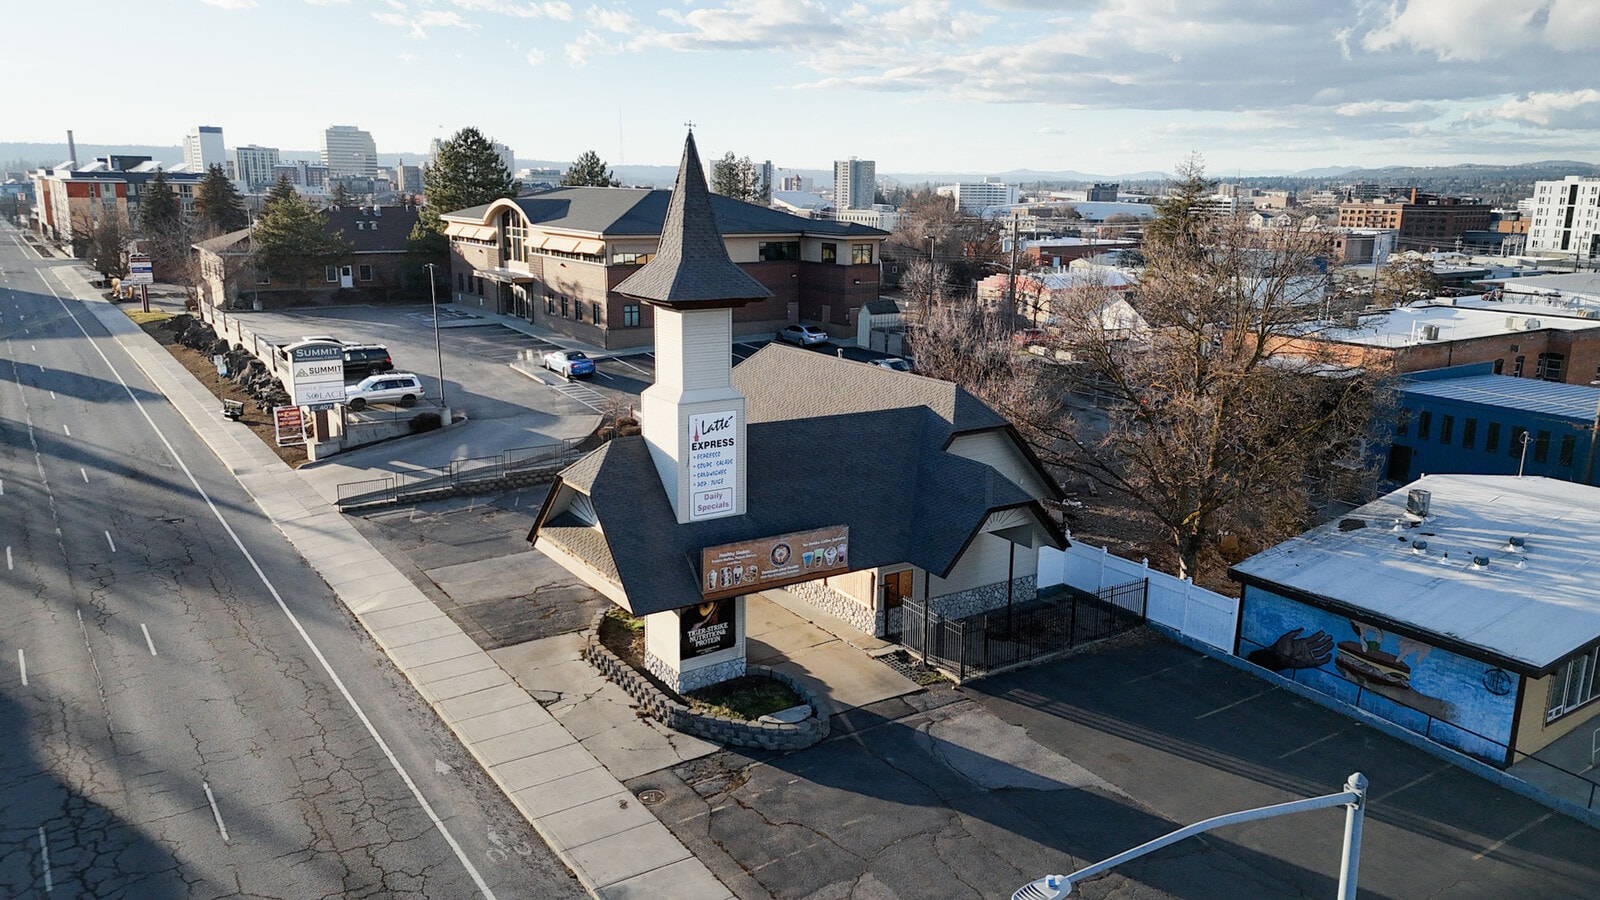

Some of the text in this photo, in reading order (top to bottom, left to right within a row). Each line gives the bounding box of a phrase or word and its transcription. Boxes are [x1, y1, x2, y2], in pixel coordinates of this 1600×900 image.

[296, 348, 339, 357] SUMMIT
[309, 365, 342, 375] SUMMIT
[306, 391, 344, 400] SOLACE
[692, 438, 735, 451] EXPRESS
[704, 491, 723, 501] Daily
[697, 501, 730, 512] Specials
[695, 635, 721, 647] PROTEIN
